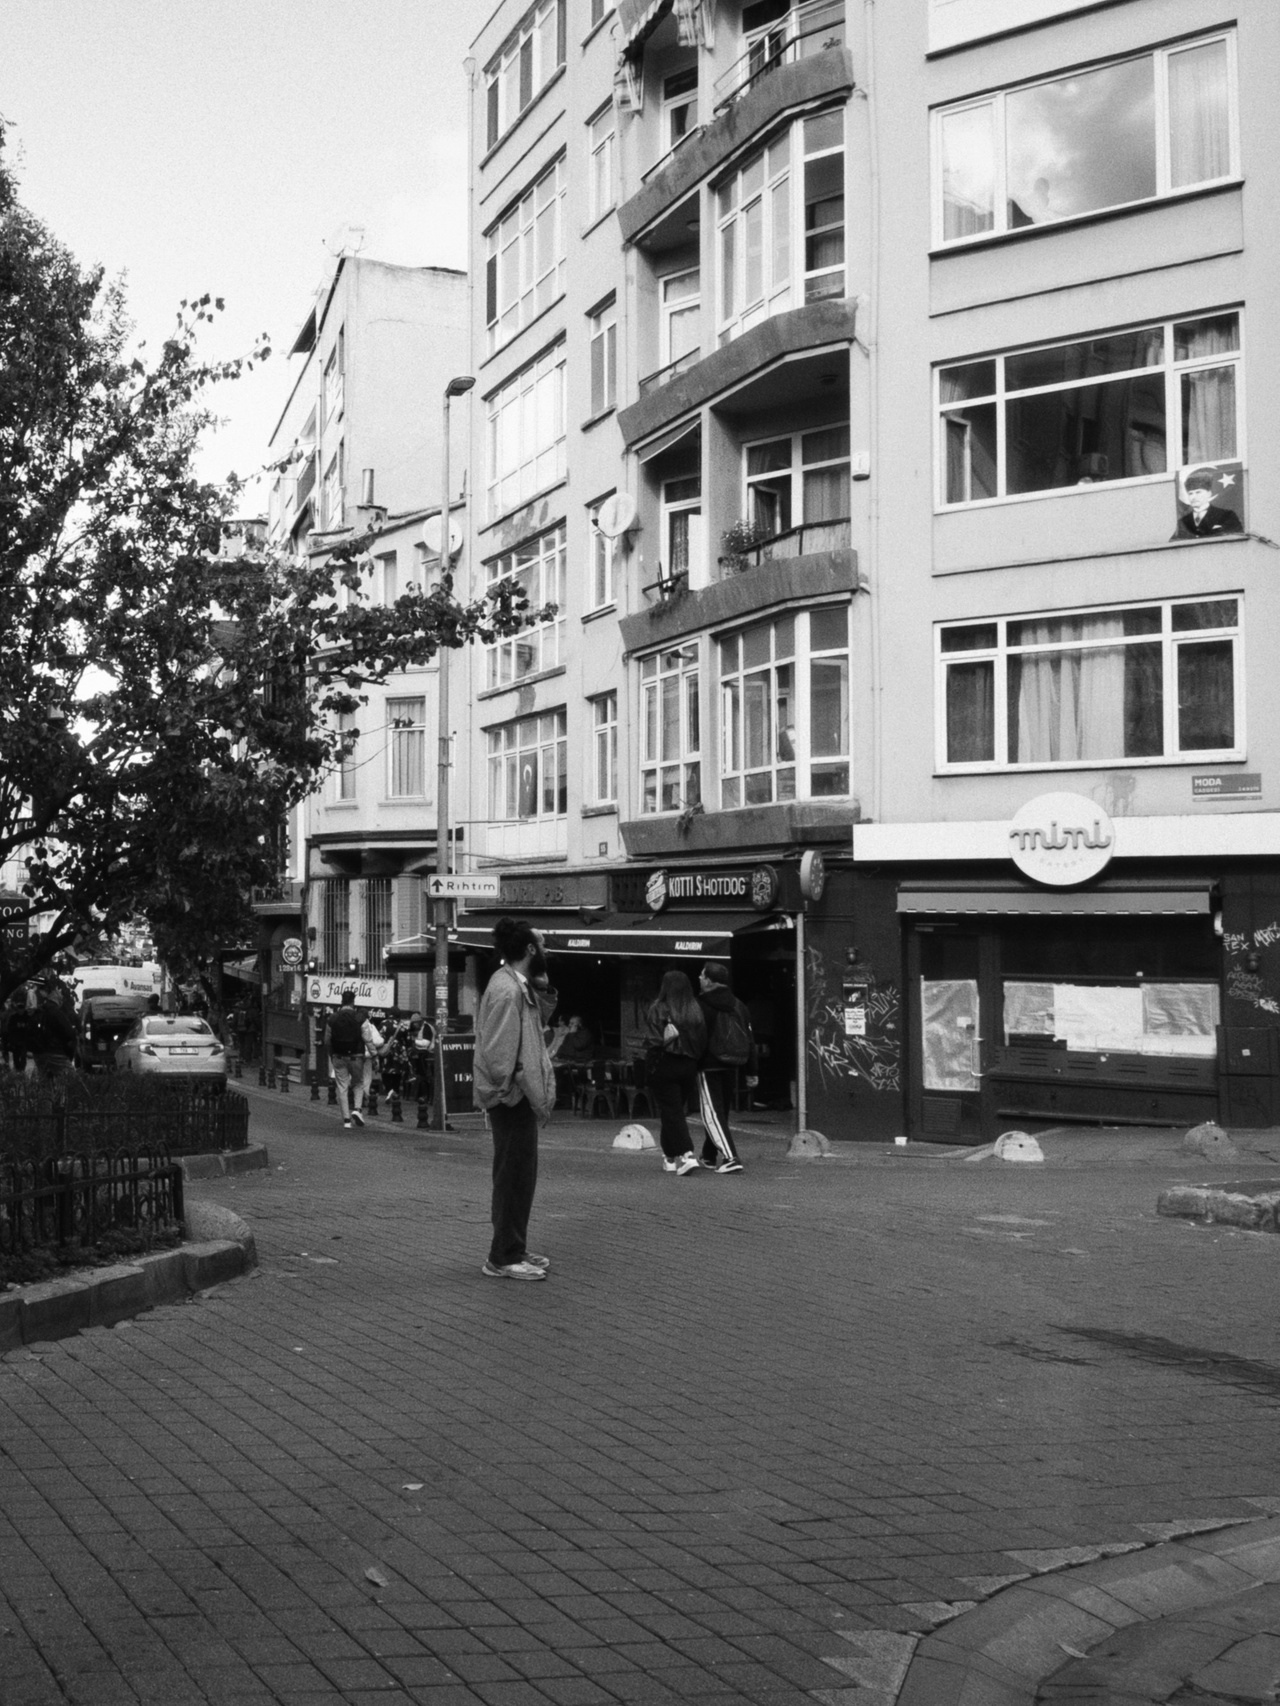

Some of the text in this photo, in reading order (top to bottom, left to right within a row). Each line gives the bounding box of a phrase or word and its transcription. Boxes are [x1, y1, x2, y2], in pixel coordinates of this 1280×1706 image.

[1194, 778, 1222, 787] MODA
[1009, 819, 1112, 851] mini
[669, 876, 694, 898] KOTTI
[1223, 933, 1245, 942] SAN
[674, 940, 703, 951] KALDIRIM
[1222, 941, 1250, 951] TEX
[443, 1043, 463, 1051] HAPPY
